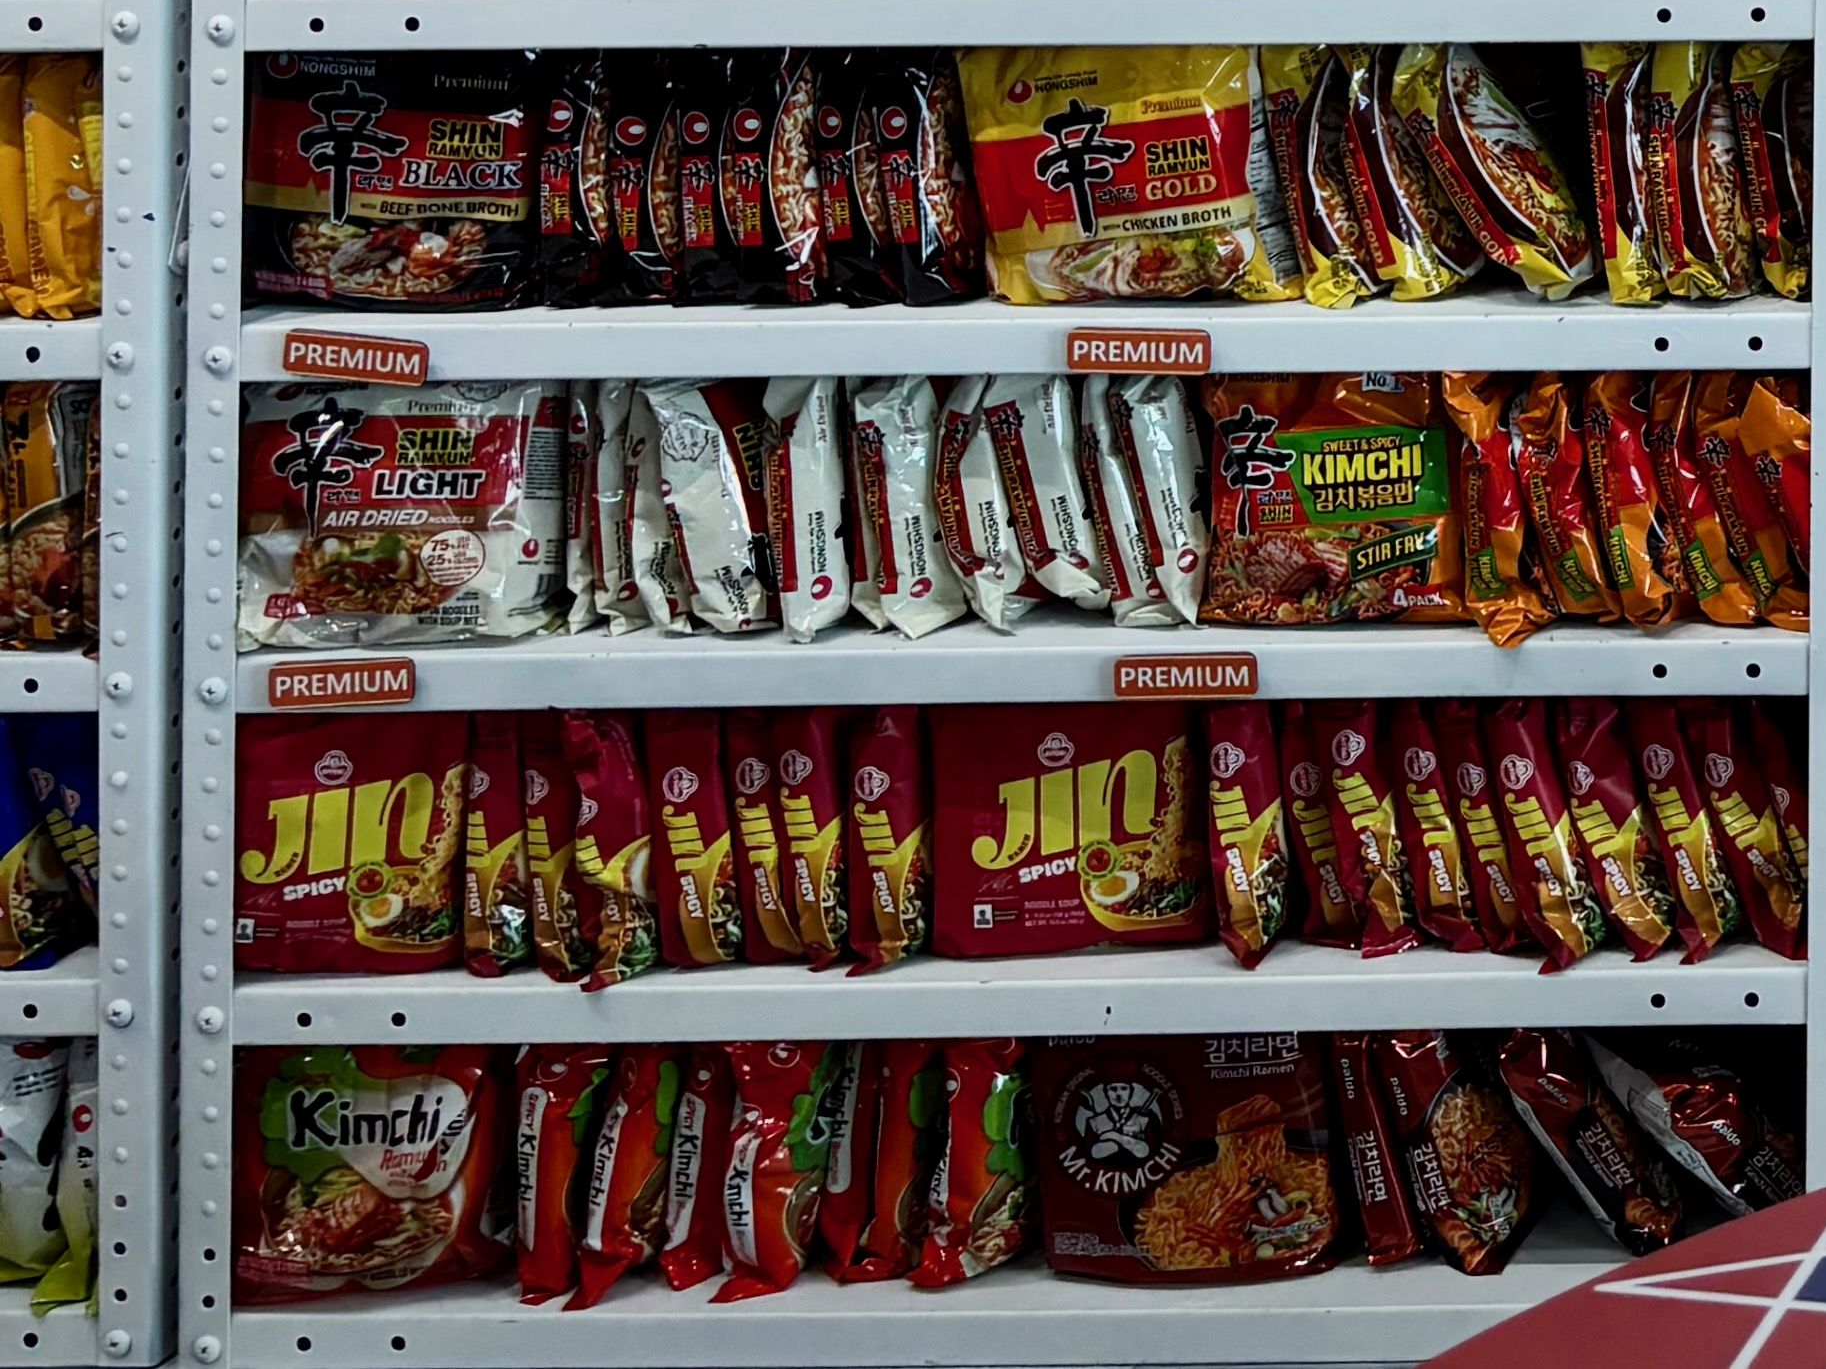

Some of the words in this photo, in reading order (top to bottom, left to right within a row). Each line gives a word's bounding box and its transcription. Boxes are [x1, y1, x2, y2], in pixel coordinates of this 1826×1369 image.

[1144, 134, 1209, 164] SHIN
[401, 160, 522, 189] BLACK
[1144, 172, 1218, 201] GOLD
[1120, 211, 1182, 232] CHICKEN
[1185, 204, 1232, 225] BROTH
[288, 341, 421, 374] PREMIUM
[1072, 340, 1204, 365] PREMIUM
[1301, 445, 1424, 488] KIMCHI
[373, 469, 487, 499] LIGHT
[1312, 482, 1416, 514] 김치볶음면
[322, 509, 357, 529] AIR
[359, 508, 428, 529] DRIED
[1356, 541, 1392, 569] STIR
[1394, 532, 1425, 559] FRY
[274, 667, 409, 698] PREMIUM
[1120, 664, 1250, 690] PREMIUM
[240, 770, 434, 884] JIN
[287, 1088, 445, 1150] Kimchi
